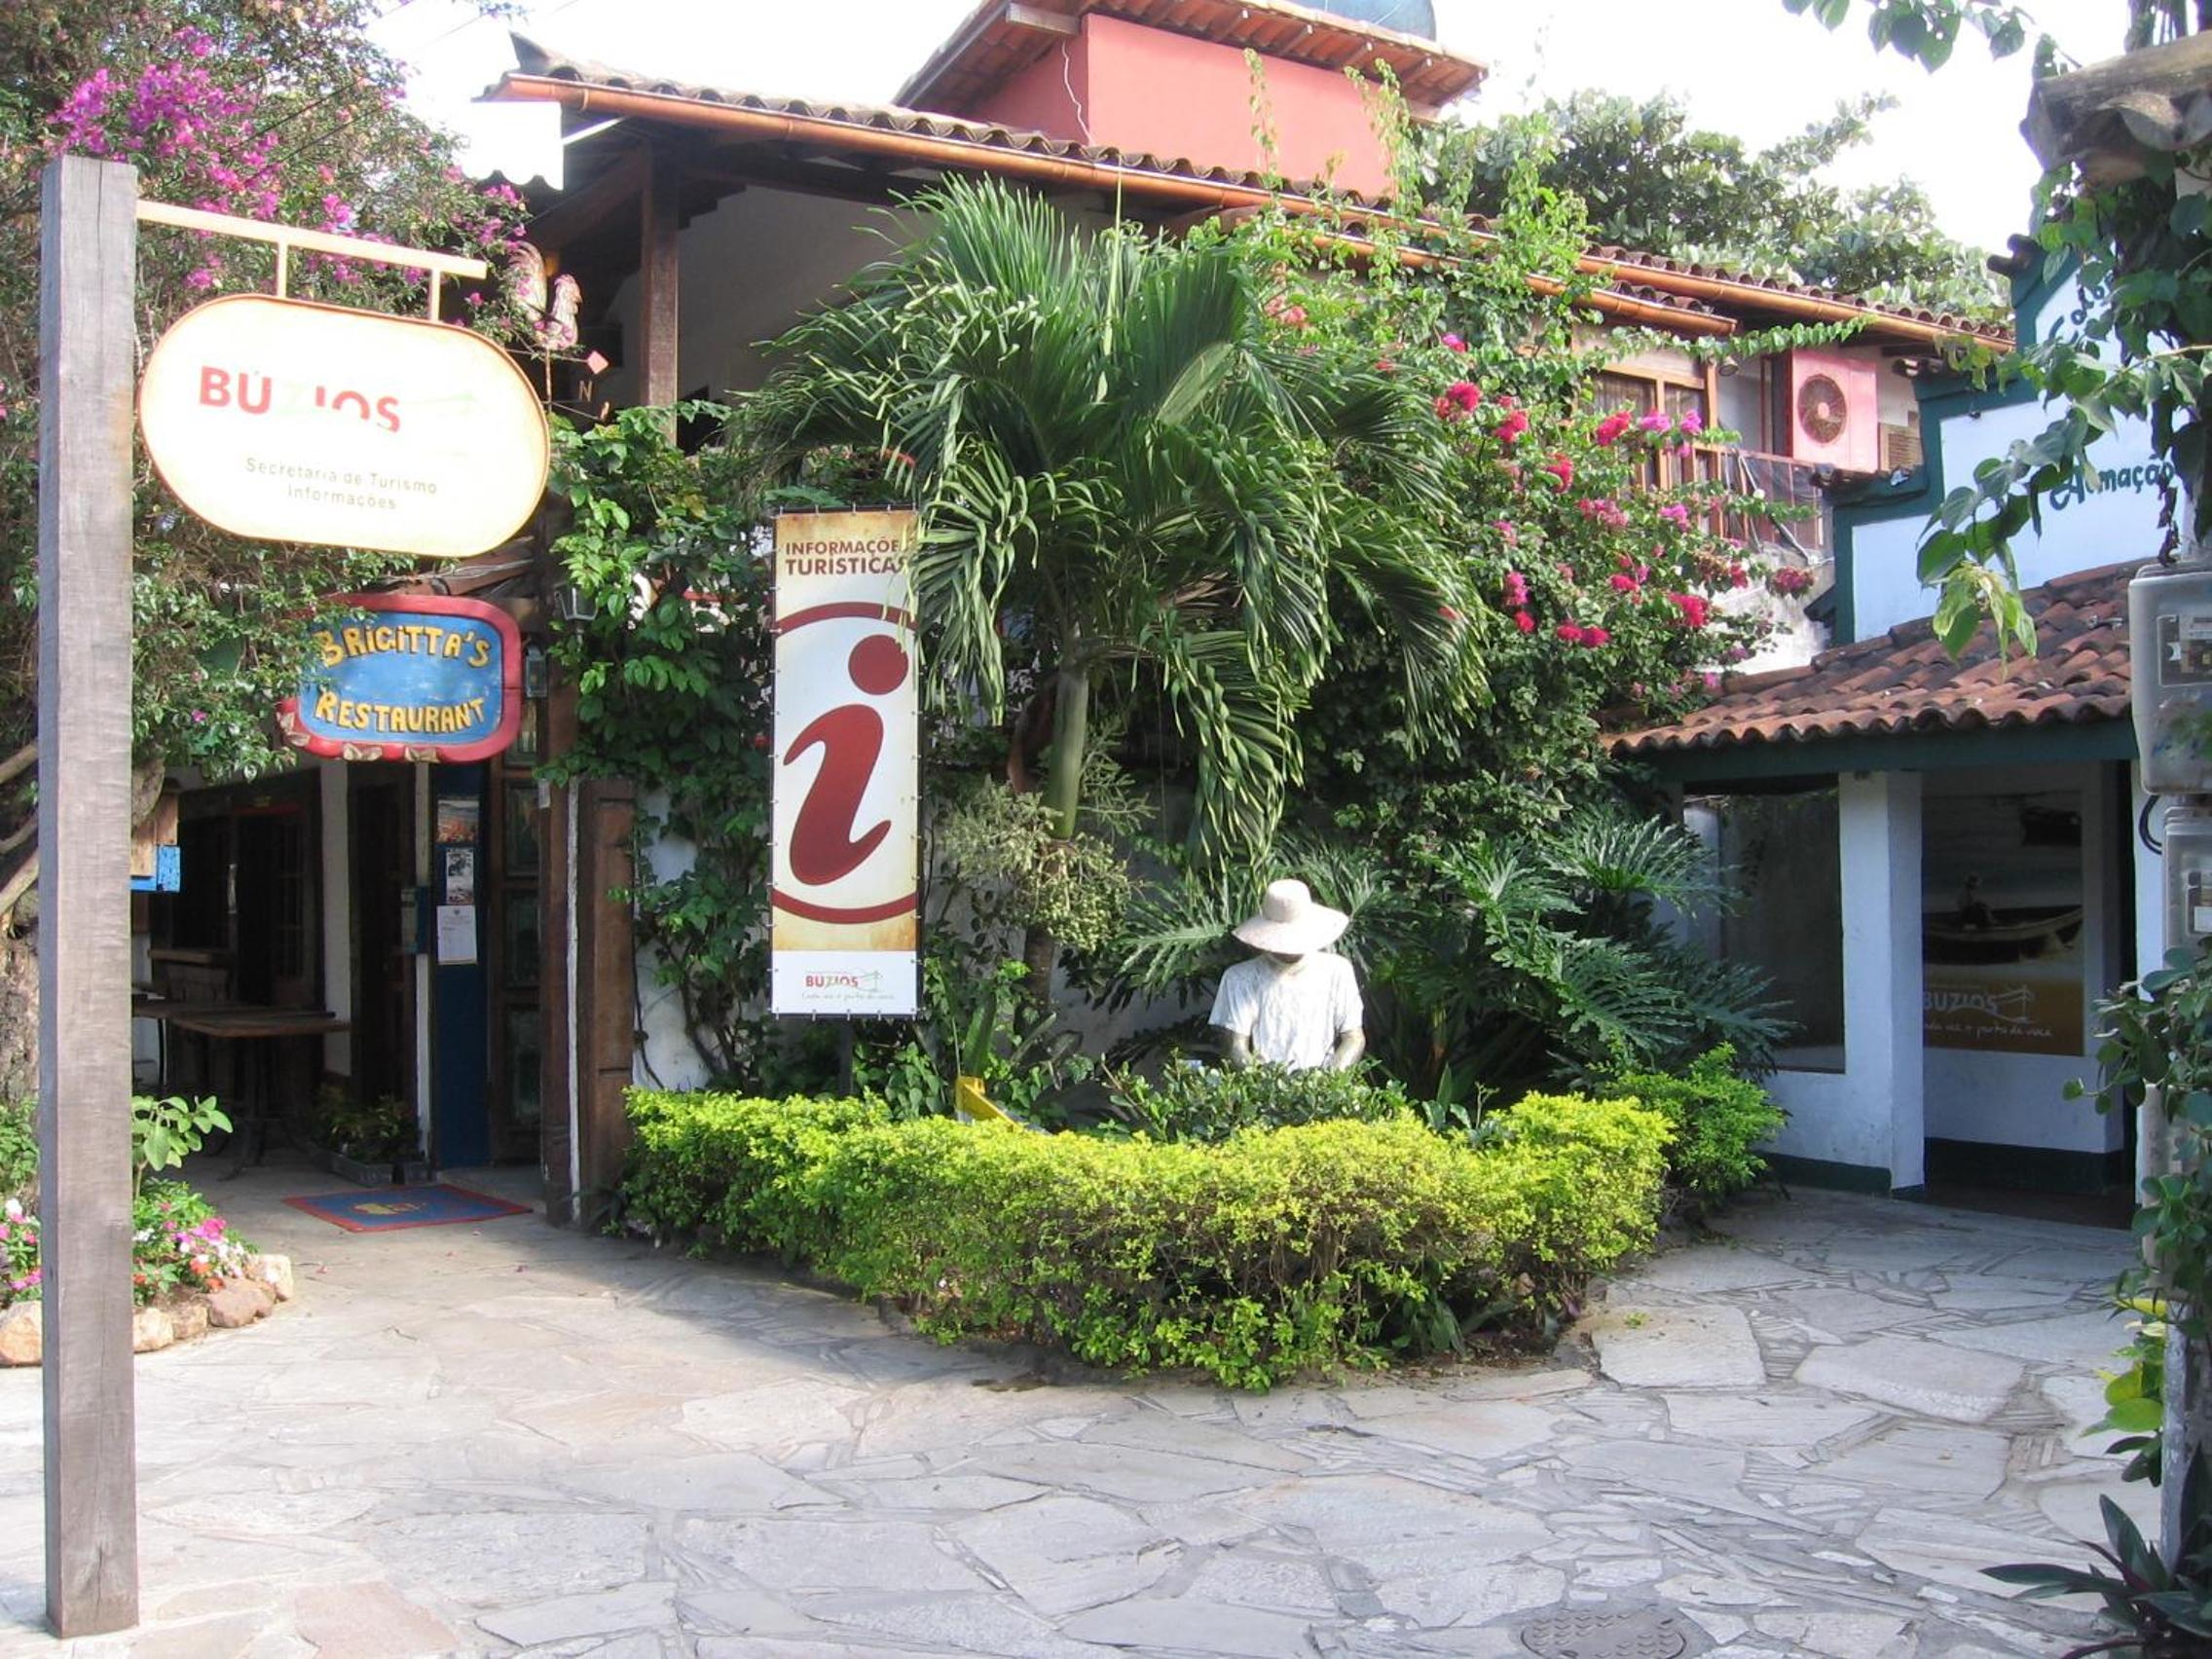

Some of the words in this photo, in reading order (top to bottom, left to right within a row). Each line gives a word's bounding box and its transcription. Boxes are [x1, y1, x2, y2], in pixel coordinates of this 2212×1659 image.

[245, 455, 337, 483] Secretaria
[344, 469, 362, 486] de
[370, 472, 437, 495] Turismo
[2049, 454, 2176, 511] Amação
[288, 482, 397, 510] Informações
[786, 536, 905, 557] INFORMAÇÕE
[314, 687, 485, 733] RESTAURANT
